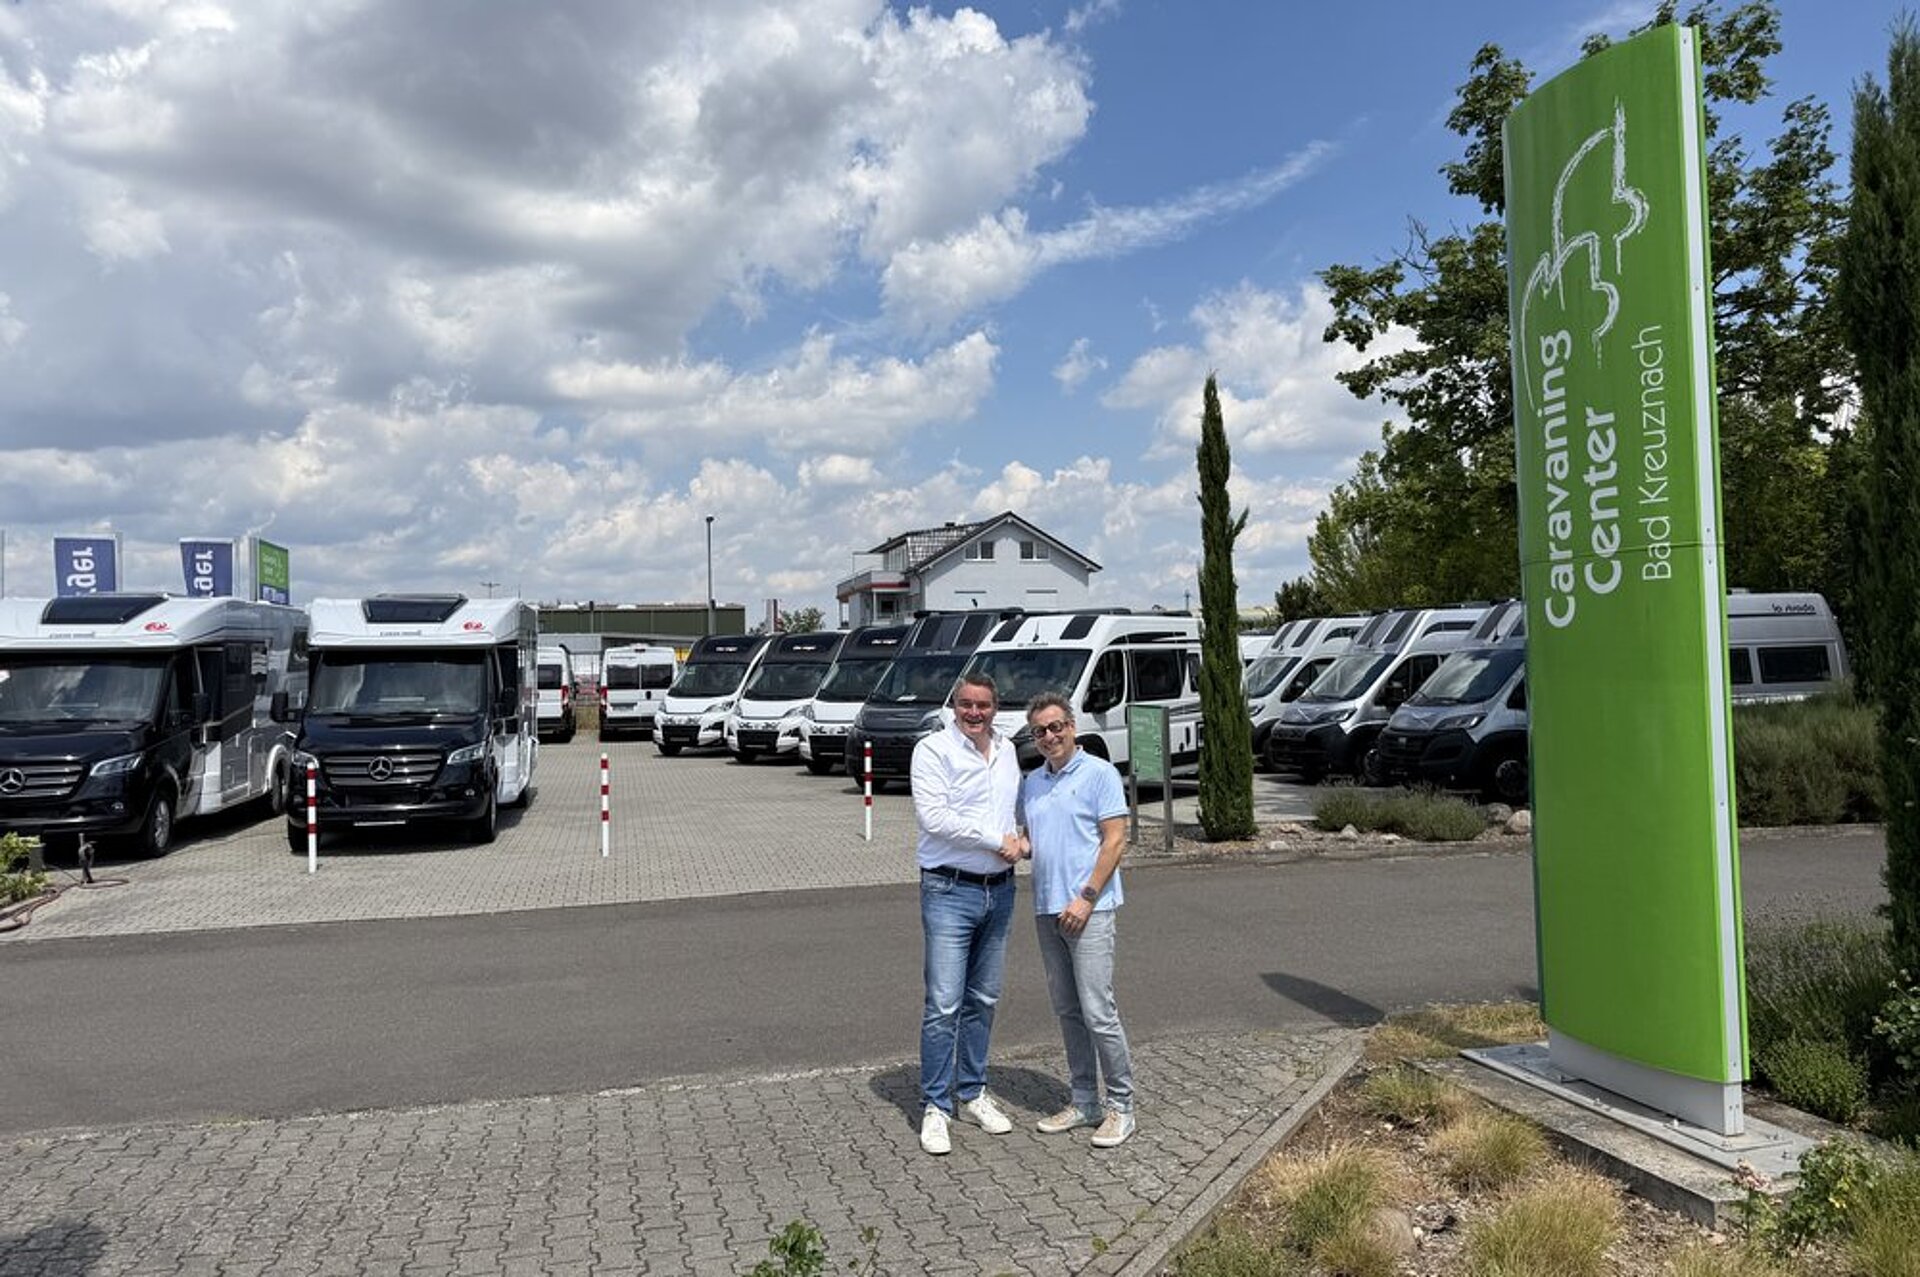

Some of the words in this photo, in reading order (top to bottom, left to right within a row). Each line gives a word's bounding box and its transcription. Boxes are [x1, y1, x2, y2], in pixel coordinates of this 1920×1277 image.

[1538, 329, 1575, 628] Caravaning
[1583, 406, 1622, 594] Center
[1631, 324, 1669, 505] Kreuznach
[1638, 516, 1671, 581] Bad
